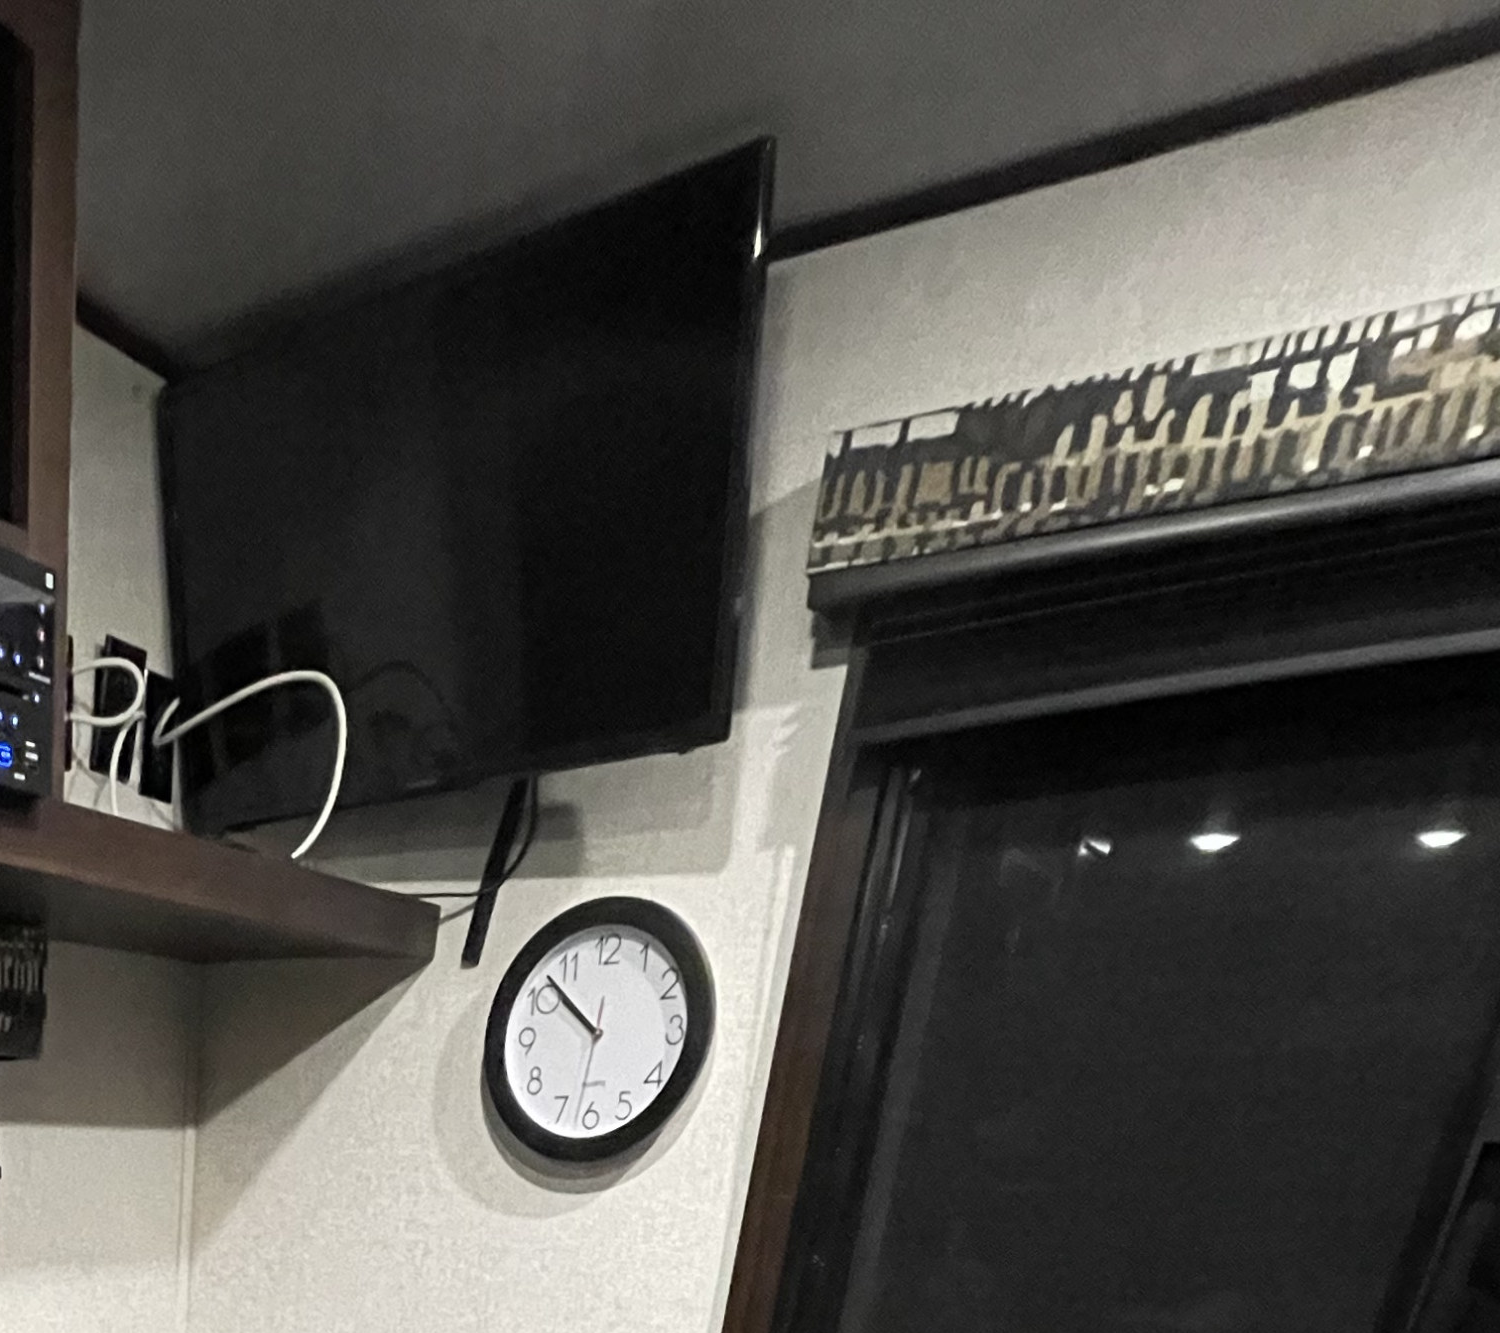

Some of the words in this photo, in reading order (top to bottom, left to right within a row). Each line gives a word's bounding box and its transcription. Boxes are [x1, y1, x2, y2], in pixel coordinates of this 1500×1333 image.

[595, 932, 622, 966] 12
[640, 942, 651, 972] 1
[559, 952, 580, 983] 11
[660, 966, 680, 1001] 2
[527, 982, 561, 1016] 10
[518, 1026, 537, 1056] 9
[665, 1014, 685, 1046] 3
[526, 1066, 543, 1096] 8
[643, 1059, 665, 1089] 4
[553, 1095, 569, 1124] 7
[581, 1101, 601, 1130] 6
[614, 1090, 633, 1121] 5
